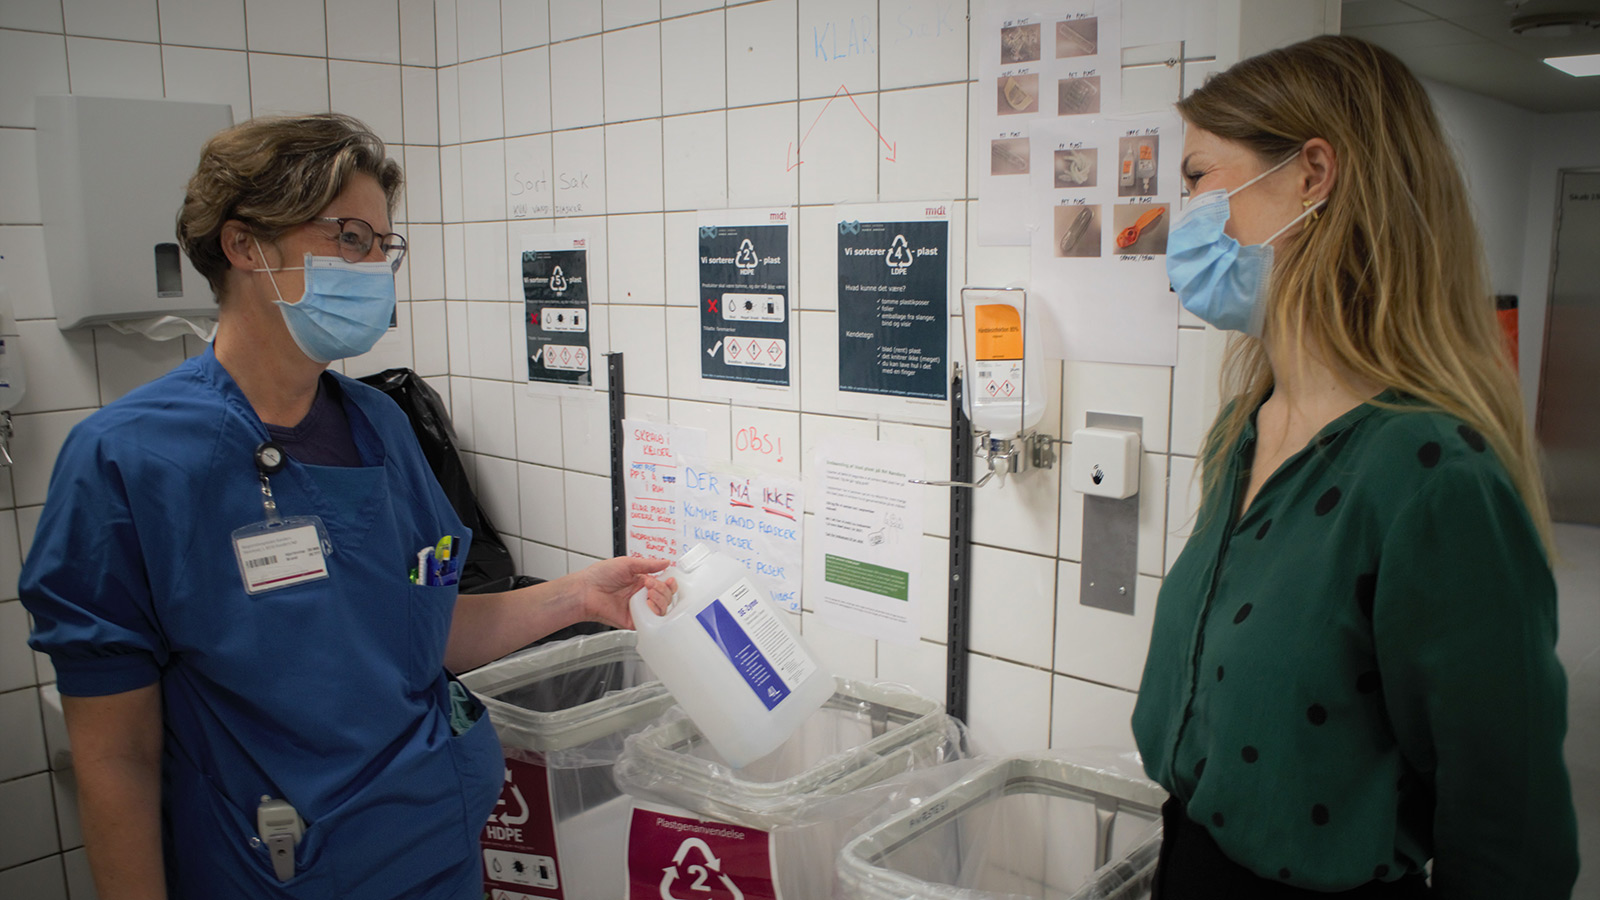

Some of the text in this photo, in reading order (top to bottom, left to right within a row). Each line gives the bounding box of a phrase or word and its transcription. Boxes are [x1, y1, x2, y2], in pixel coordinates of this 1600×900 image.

[813, 14, 875, 62] KLAR
[511, 169, 547, 196] Sort
[700, 256, 708, 264] Vi
[709, 256, 735, 264] sorterer
[743, 248, 750, 261] 2
[763, 256, 781, 266] plast
[844, 247, 853, 256] Vi
[854, 247, 886, 256] sorterer
[894, 246, 902, 259] 4
[917, 247, 938, 257] plast
[888, 285, 906, 293] være?
[845, 331, 874, 340] Kendetegn
[736, 426, 783, 463] OBS!
[685, 466, 720, 496] DER
[729, 479, 751, 503] MÅ
[762, 486, 795, 513] IKKE
[682, 500, 718, 522] KOMME
[758, 520, 797, 541] FLASKER
[693, 526, 721, 544] KLARE
[485, 825, 524, 843] HDPE
[656, 817, 746, 840] Plastgenanvendelse
[687, 864, 712, 892] 2
